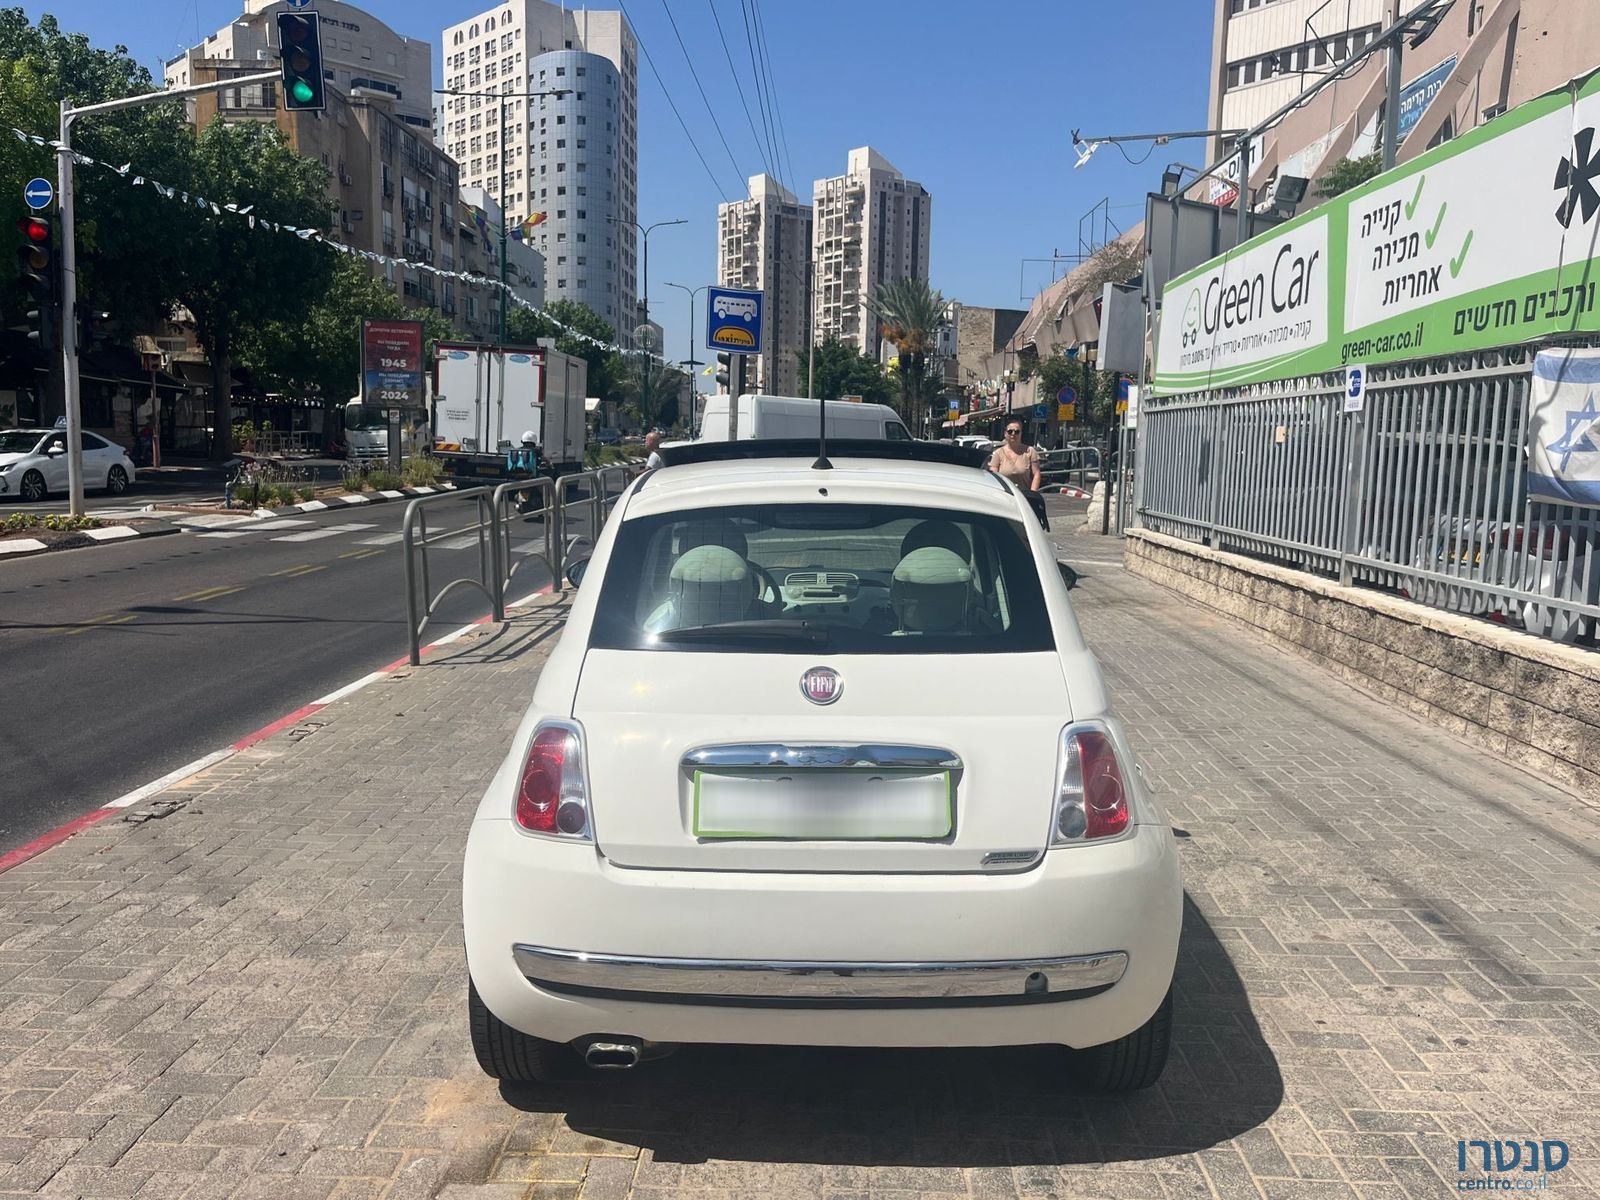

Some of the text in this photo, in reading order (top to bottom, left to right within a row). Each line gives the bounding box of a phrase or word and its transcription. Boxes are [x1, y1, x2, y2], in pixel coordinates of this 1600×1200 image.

[1400, 88, 1425, 114] קדימה
[1361, 199, 1402, 239] קנייה
[1372, 231, 1420, 271] מכירה
[1204, 243, 1320, 335] Green Car
[1382, 264, 1442, 306] אחריות
[1453, 281, 1596, 336] ורכבים חדשים
[1267, 326, 1289, 345] מכירה
[1293, 320, 1312, 342] קניה
[1341, 322, 1423, 364] green-car.co.il
[380, 358, 407, 368] 1945
[380, 390, 409, 401] 2024
[810, 675, 834, 693] FIAT
